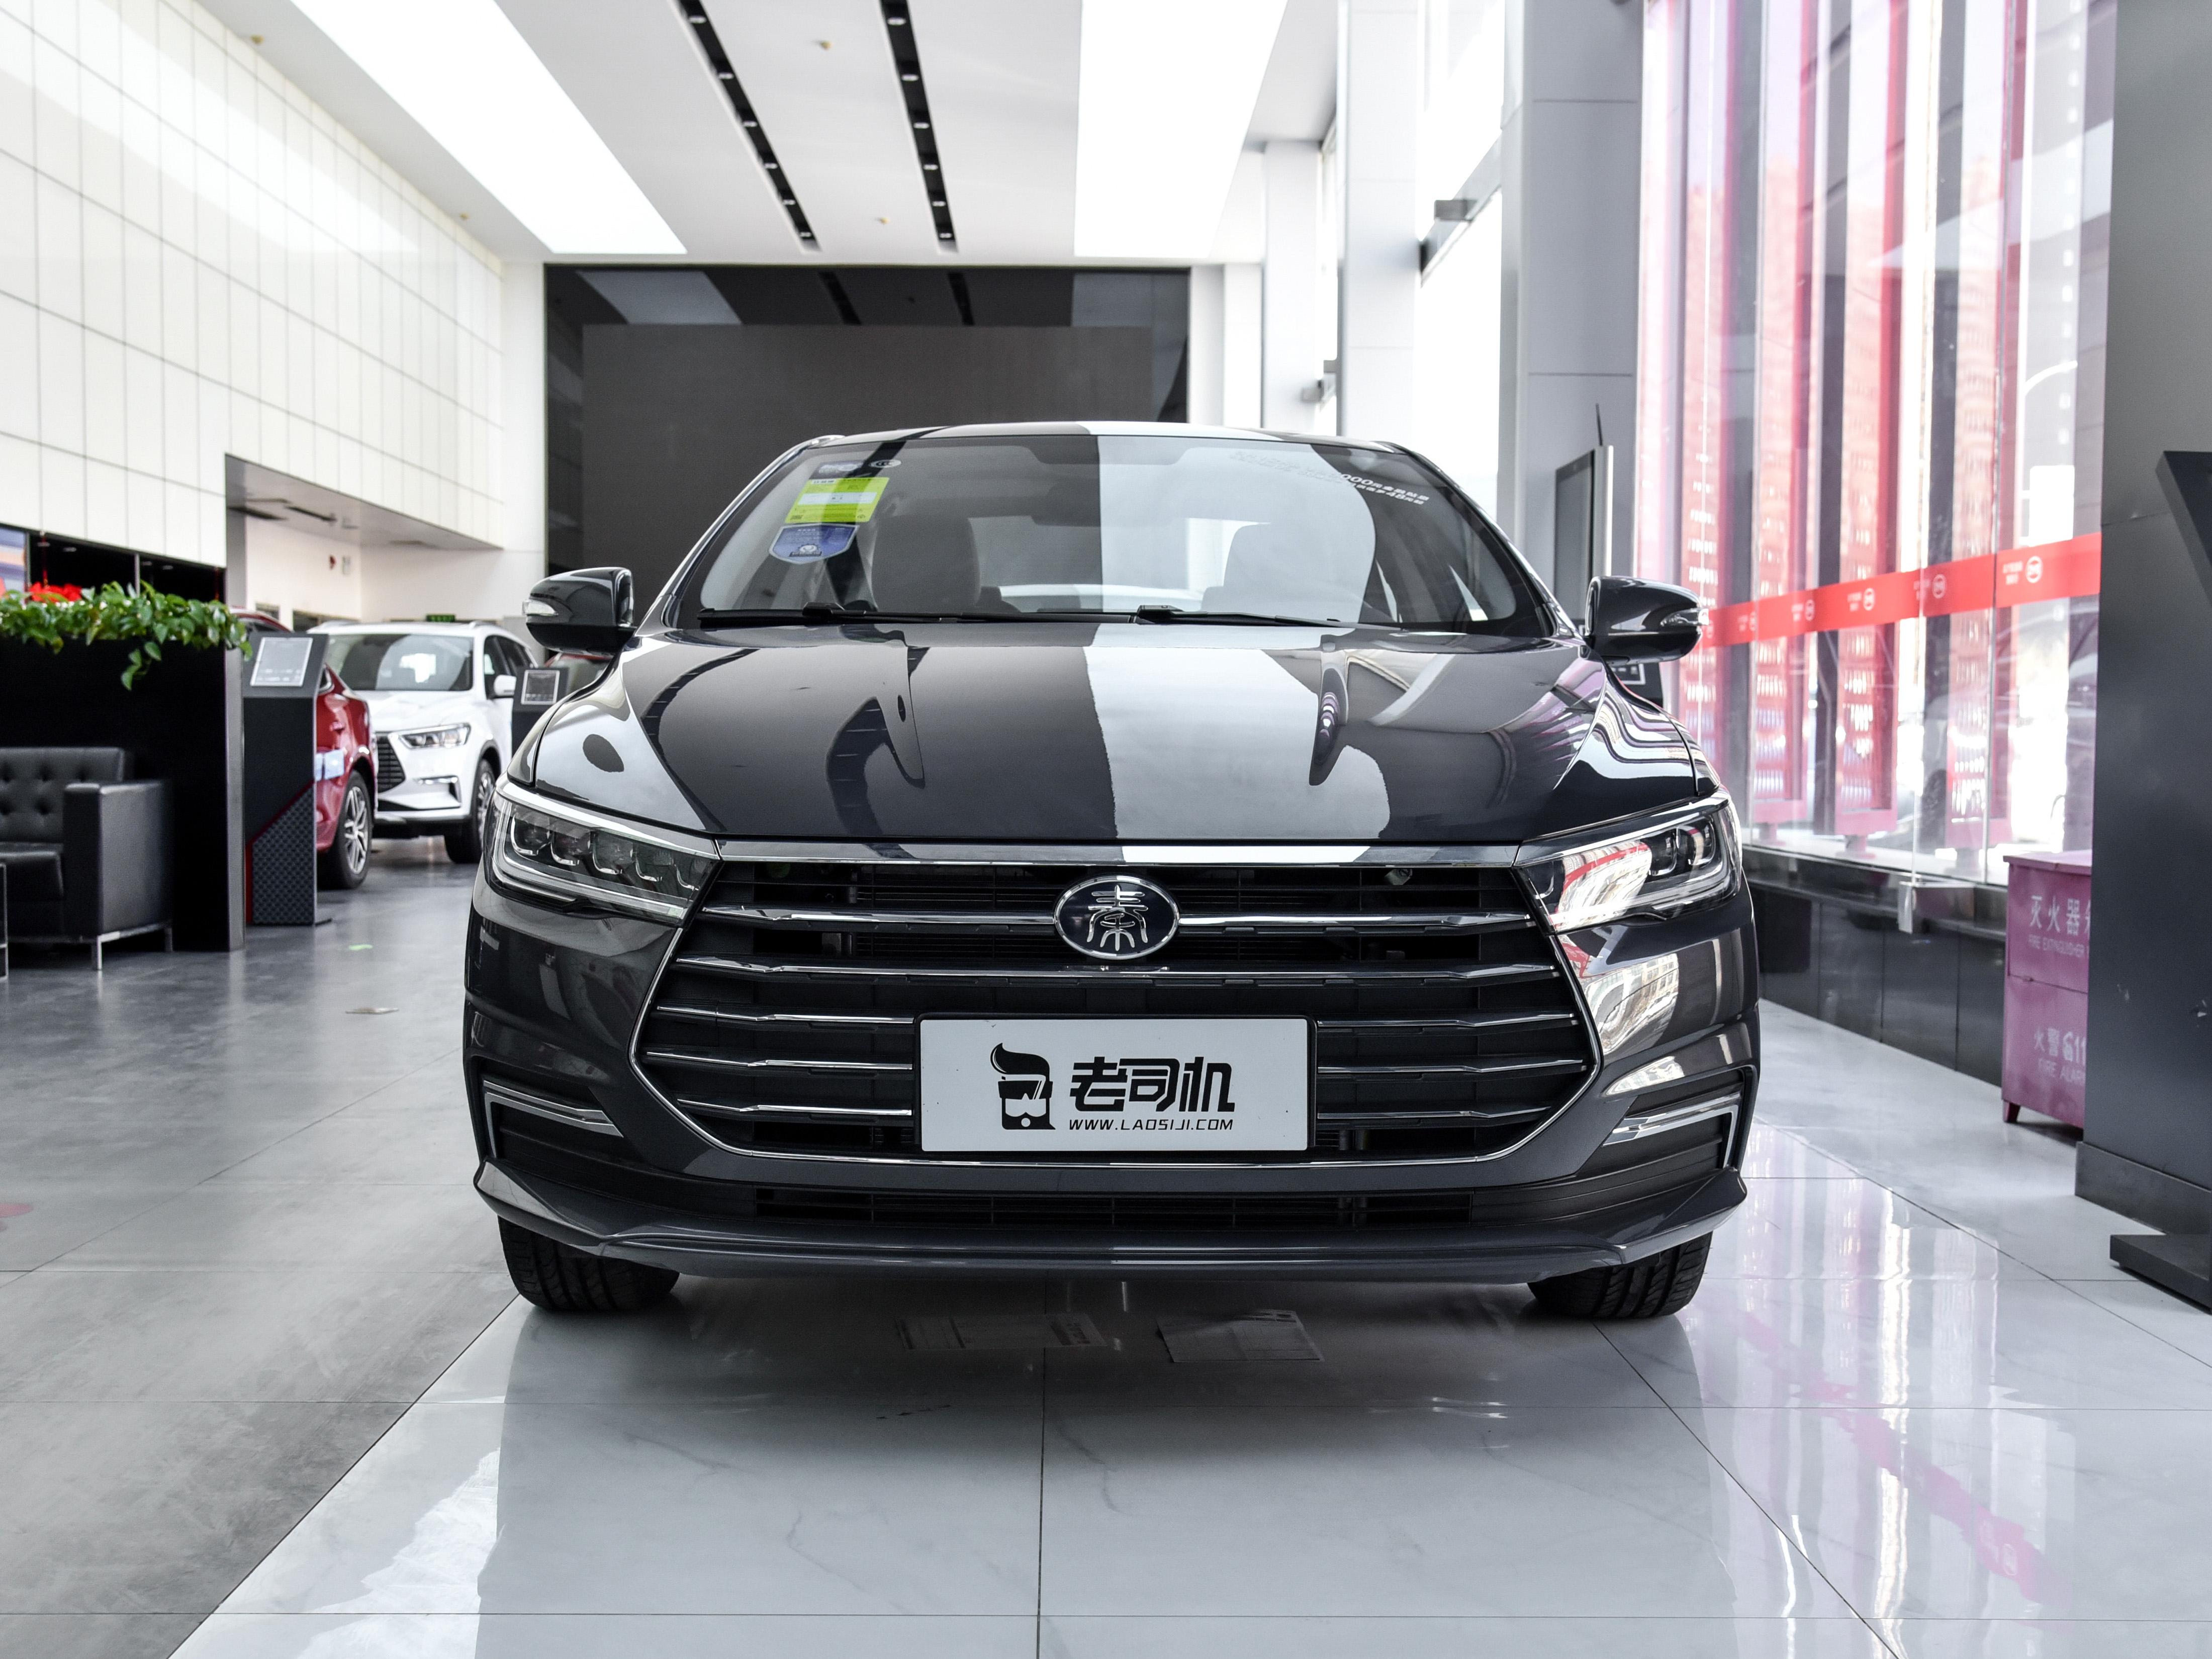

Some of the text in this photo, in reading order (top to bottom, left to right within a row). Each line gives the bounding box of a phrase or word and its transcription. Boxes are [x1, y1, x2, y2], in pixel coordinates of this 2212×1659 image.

[1087, 885, 1148, 951] 秦
[1069, 1056, 1235, 1112] 老司机
[1069, 1119, 1233, 1131] WWW.LAOSIJI.COM
